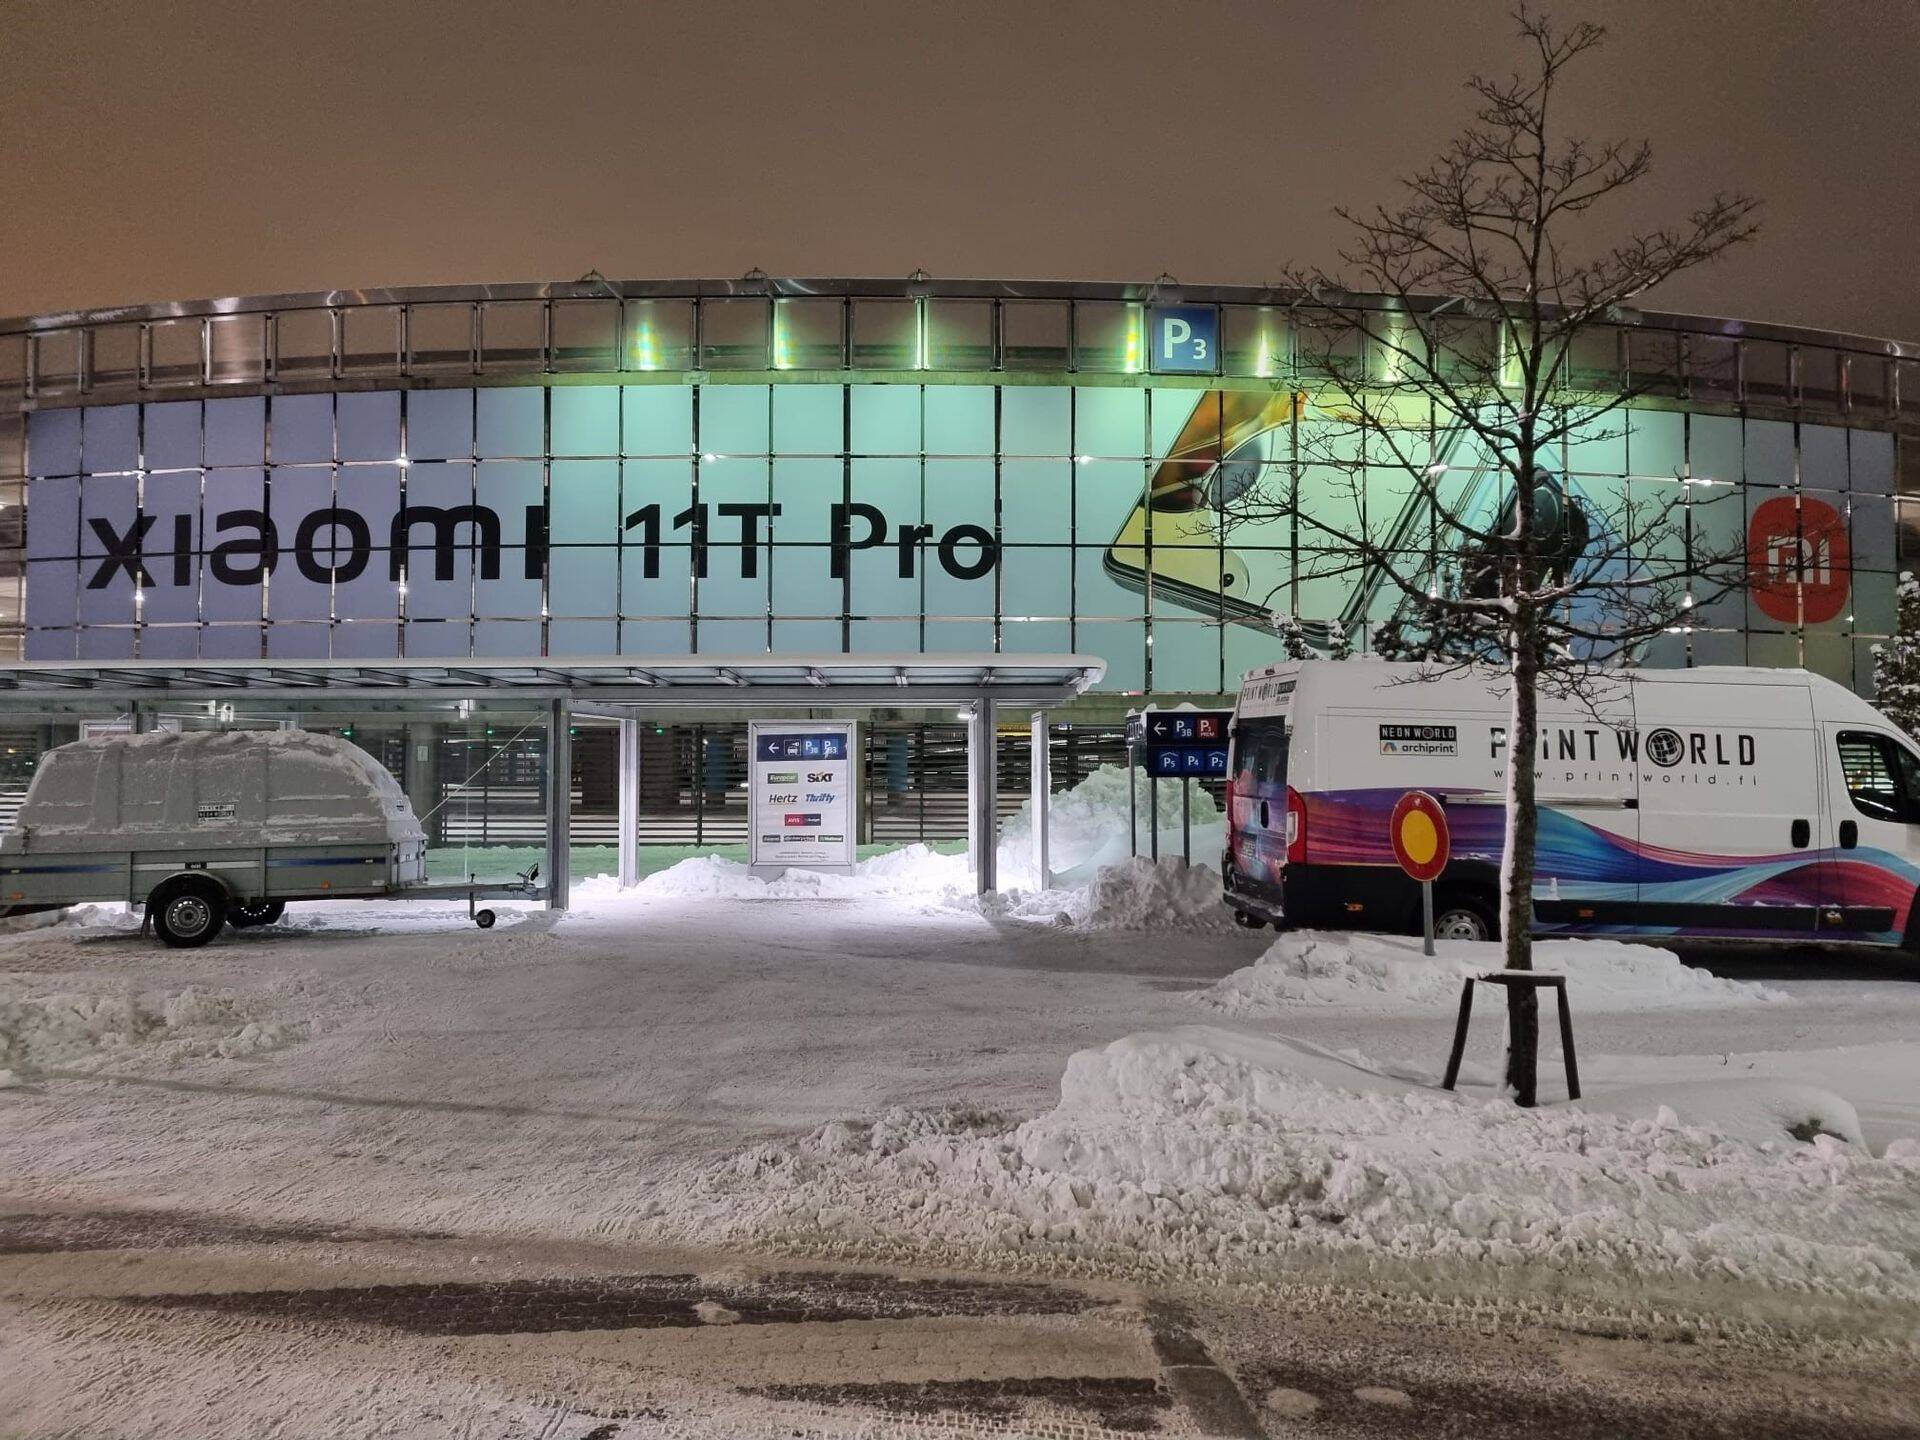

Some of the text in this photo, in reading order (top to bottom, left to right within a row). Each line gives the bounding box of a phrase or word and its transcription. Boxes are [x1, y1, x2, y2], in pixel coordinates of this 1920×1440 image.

[1164, 318, 1207, 360] P3
[625, 503, 782, 578] 11T
[830, 503, 999, 580] Pro
[1382, 727, 1455, 739] NEON WORLD
[1402, 742, 1454, 754] archiprint
[1490, 727, 1600, 761] PINT
[1164, 755, 1223, 768] P5 P4 P2
[1494, 770, 1757, 786] ww.printworld.fi
[769, 793, 835, 803] Hertz Thrifty
